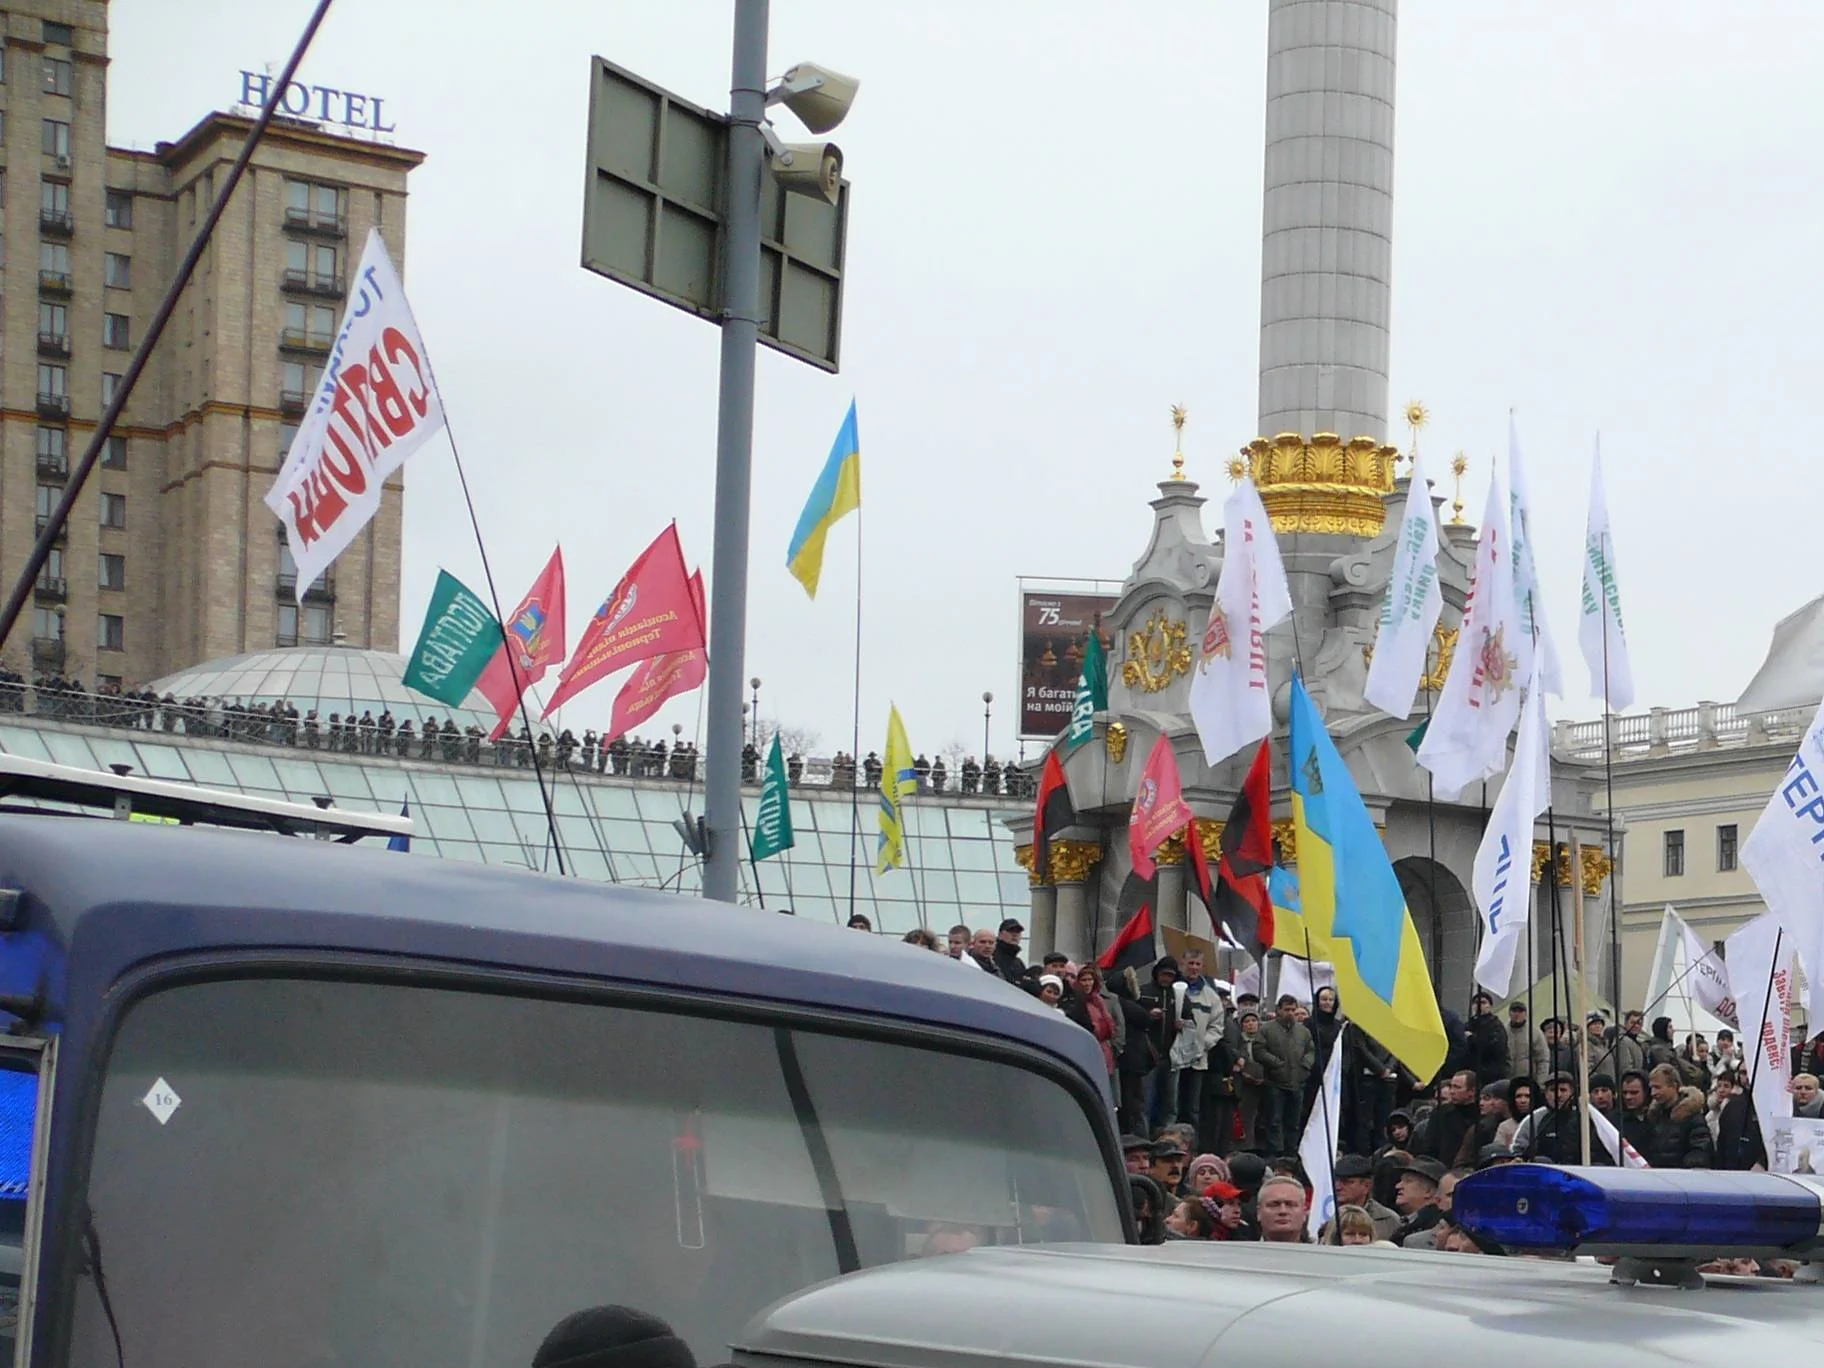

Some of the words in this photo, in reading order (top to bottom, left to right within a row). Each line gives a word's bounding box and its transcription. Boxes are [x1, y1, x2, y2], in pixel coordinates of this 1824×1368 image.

[239, 70, 396, 132] HOTEL
[1038, 608, 1060, 625] 75
[1027, 687, 1035, 698] Я
[1026, 702, 1042, 712] на
[155, 1093, 173, 1106] 16
